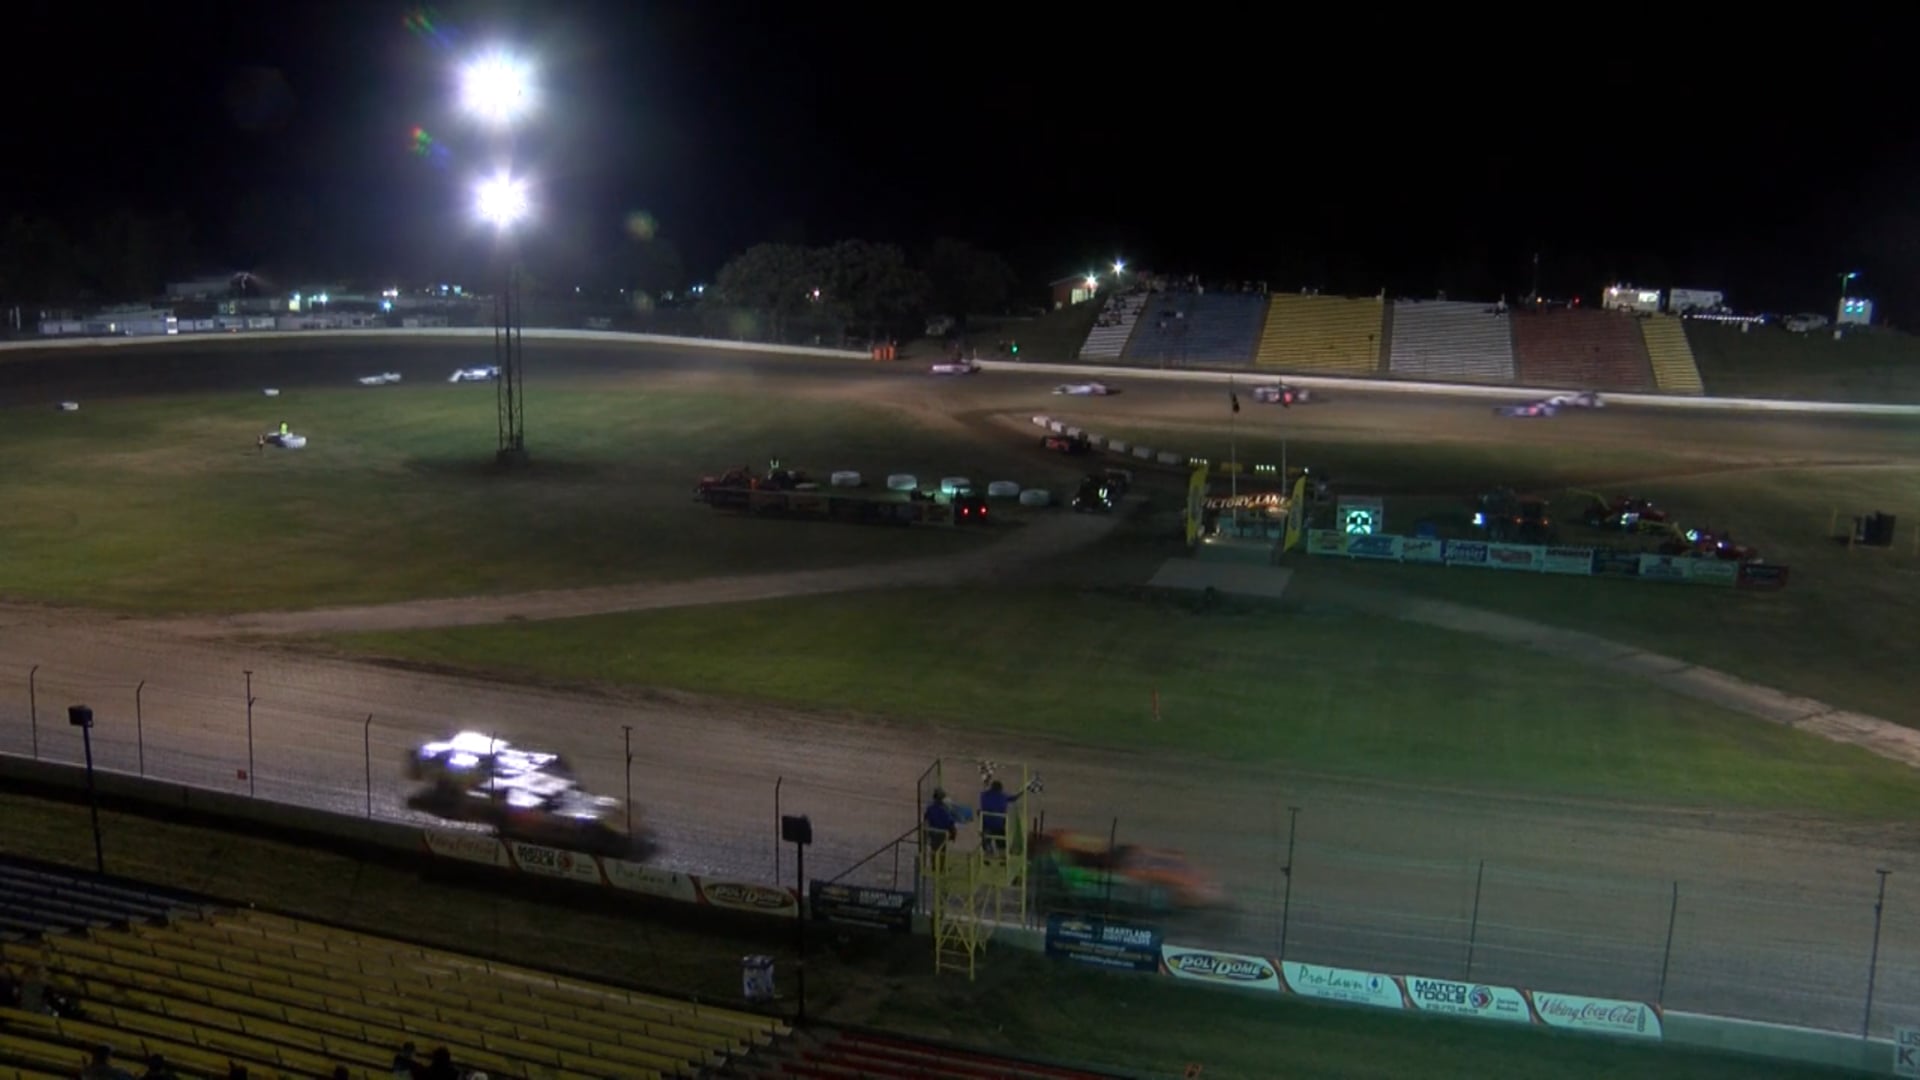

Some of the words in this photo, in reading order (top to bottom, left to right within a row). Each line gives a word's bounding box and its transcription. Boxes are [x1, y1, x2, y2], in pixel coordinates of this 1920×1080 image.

[1298, 965, 1363, 990] Pro-Lawn
[1415, 980, 1467, 994] MATCO
[1416, 990, 1465, 1004] TOOLS
